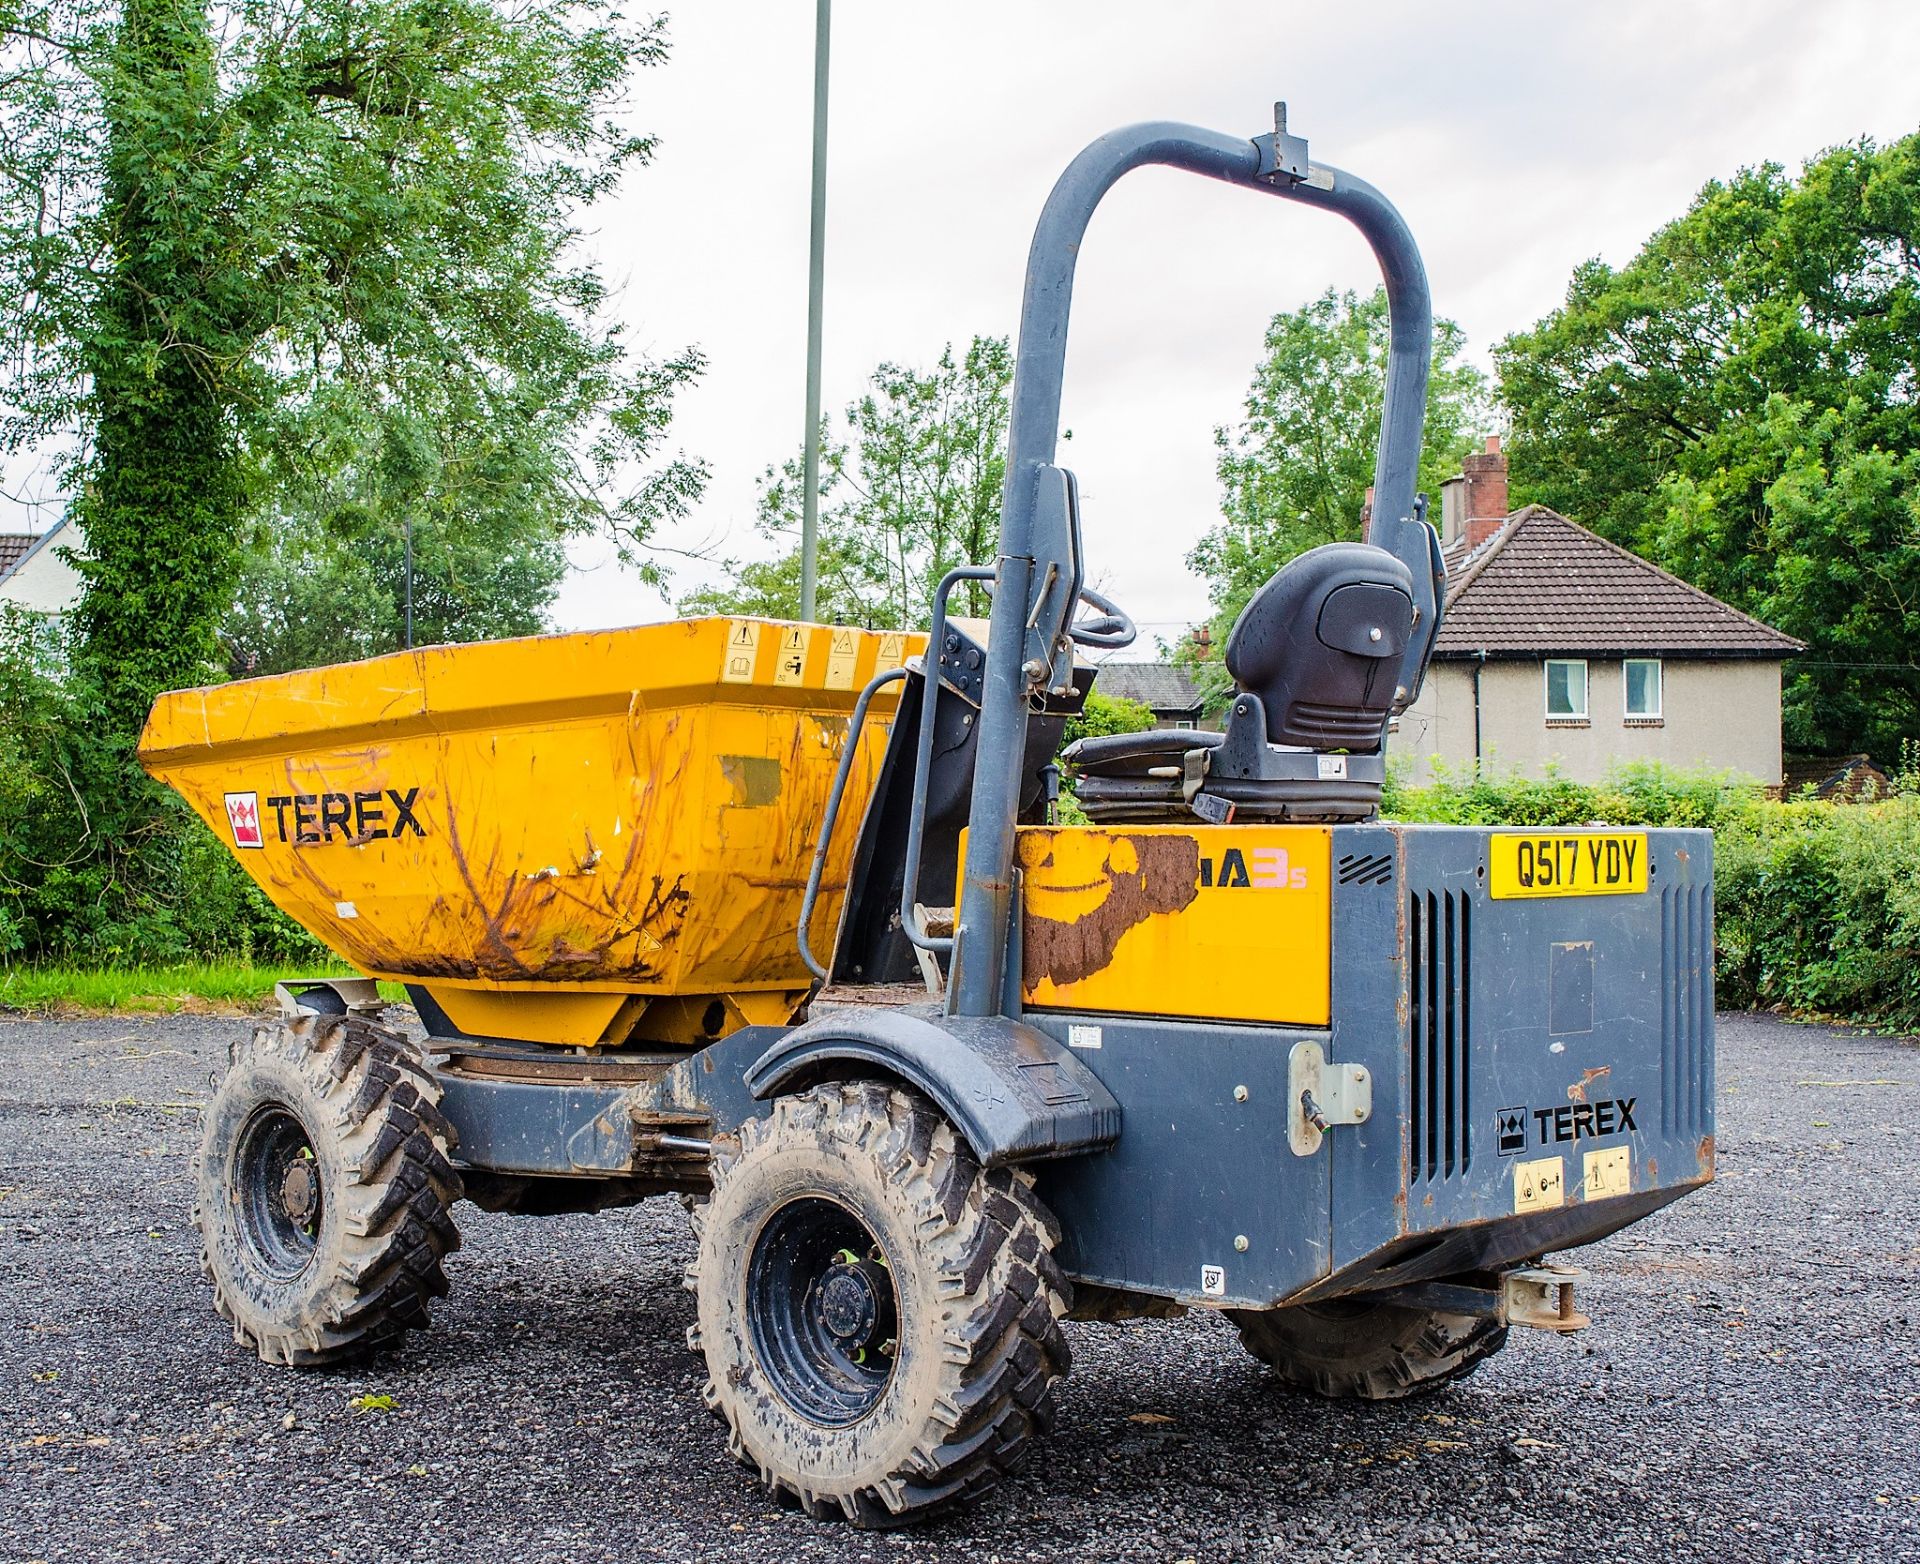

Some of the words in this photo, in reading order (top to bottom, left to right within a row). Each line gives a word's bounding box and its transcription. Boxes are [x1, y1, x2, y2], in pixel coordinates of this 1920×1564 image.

[267, 787, 428, 843] TEREX
[1518, 840, 1579, 888] Q517
[1588, 839, 1637, 884] YDY
[1533, 1097, 1638, 1145] TEREX
